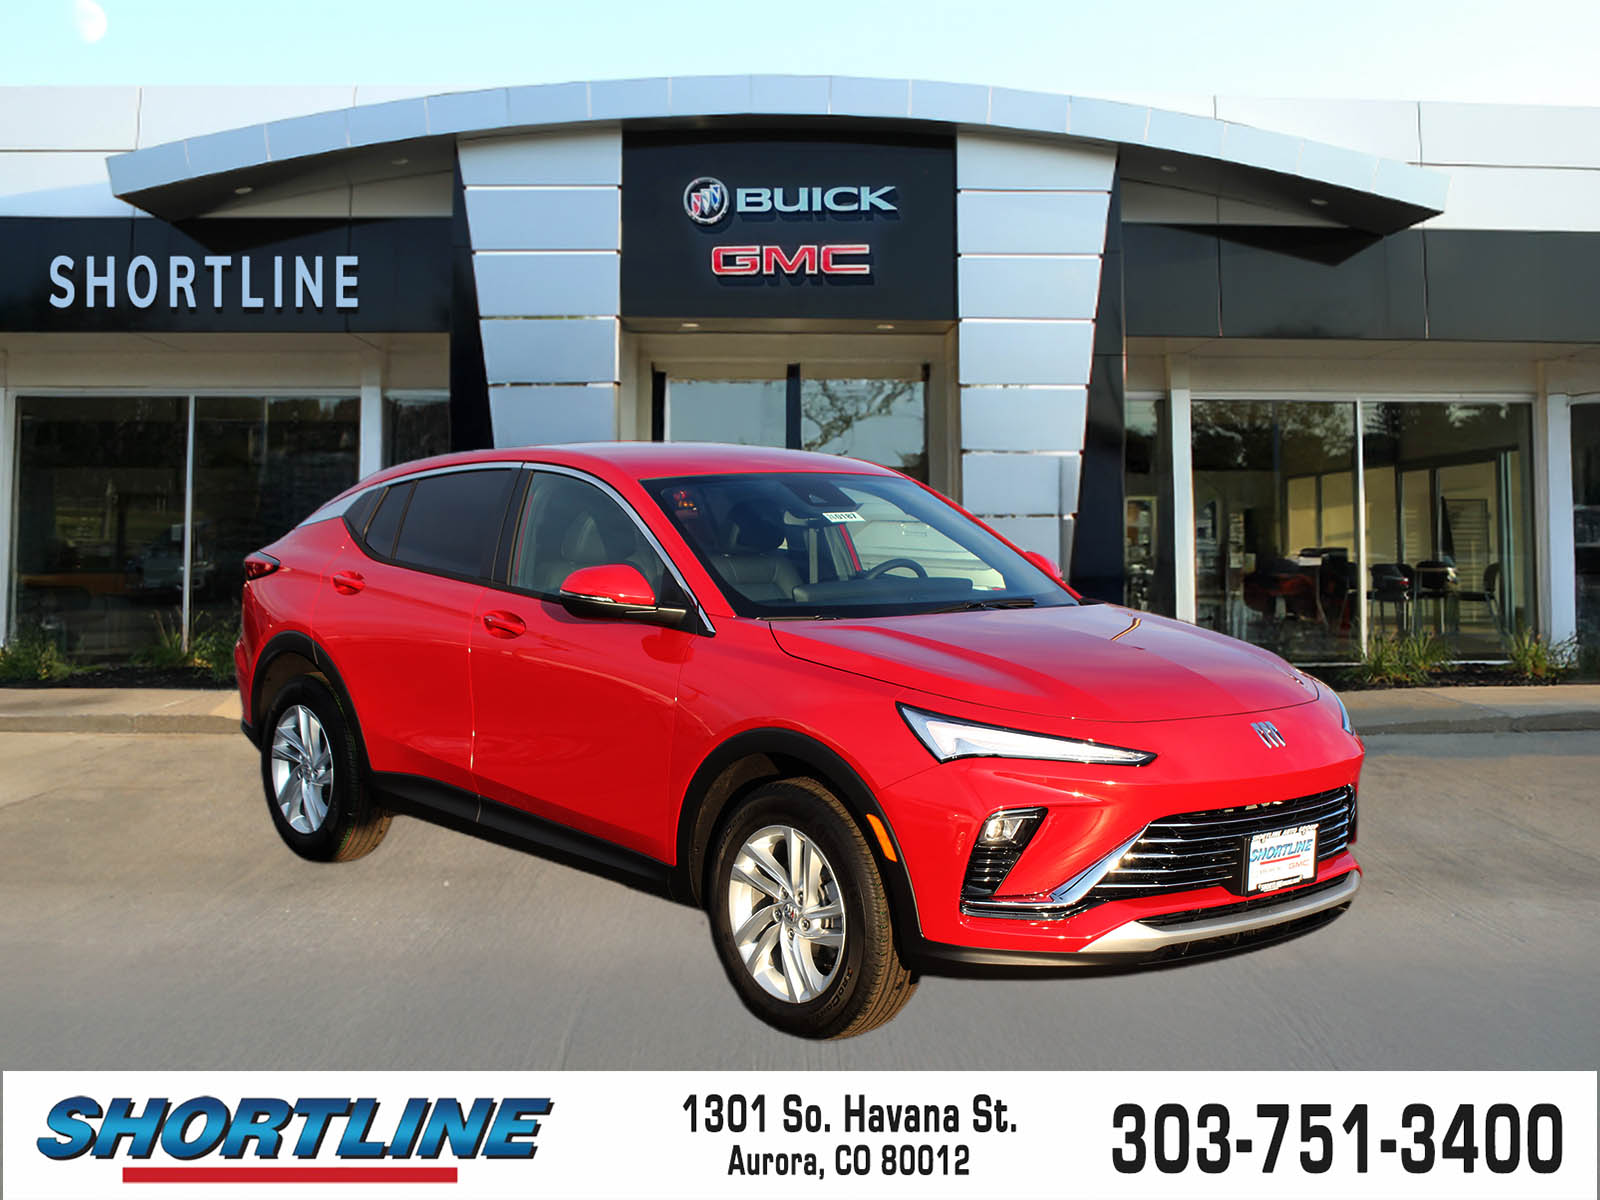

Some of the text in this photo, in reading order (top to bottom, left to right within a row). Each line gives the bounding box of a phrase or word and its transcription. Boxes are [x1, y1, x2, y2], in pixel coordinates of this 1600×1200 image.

[736, 186, 898, 213] BUICK
[711, 244, 870, 275] GMC
[49, 255, 359, 308] SHORTLINE
[1250, 838, 1313, 862] SHORTLINE
[1288, 859, 1310, 870] GMC
